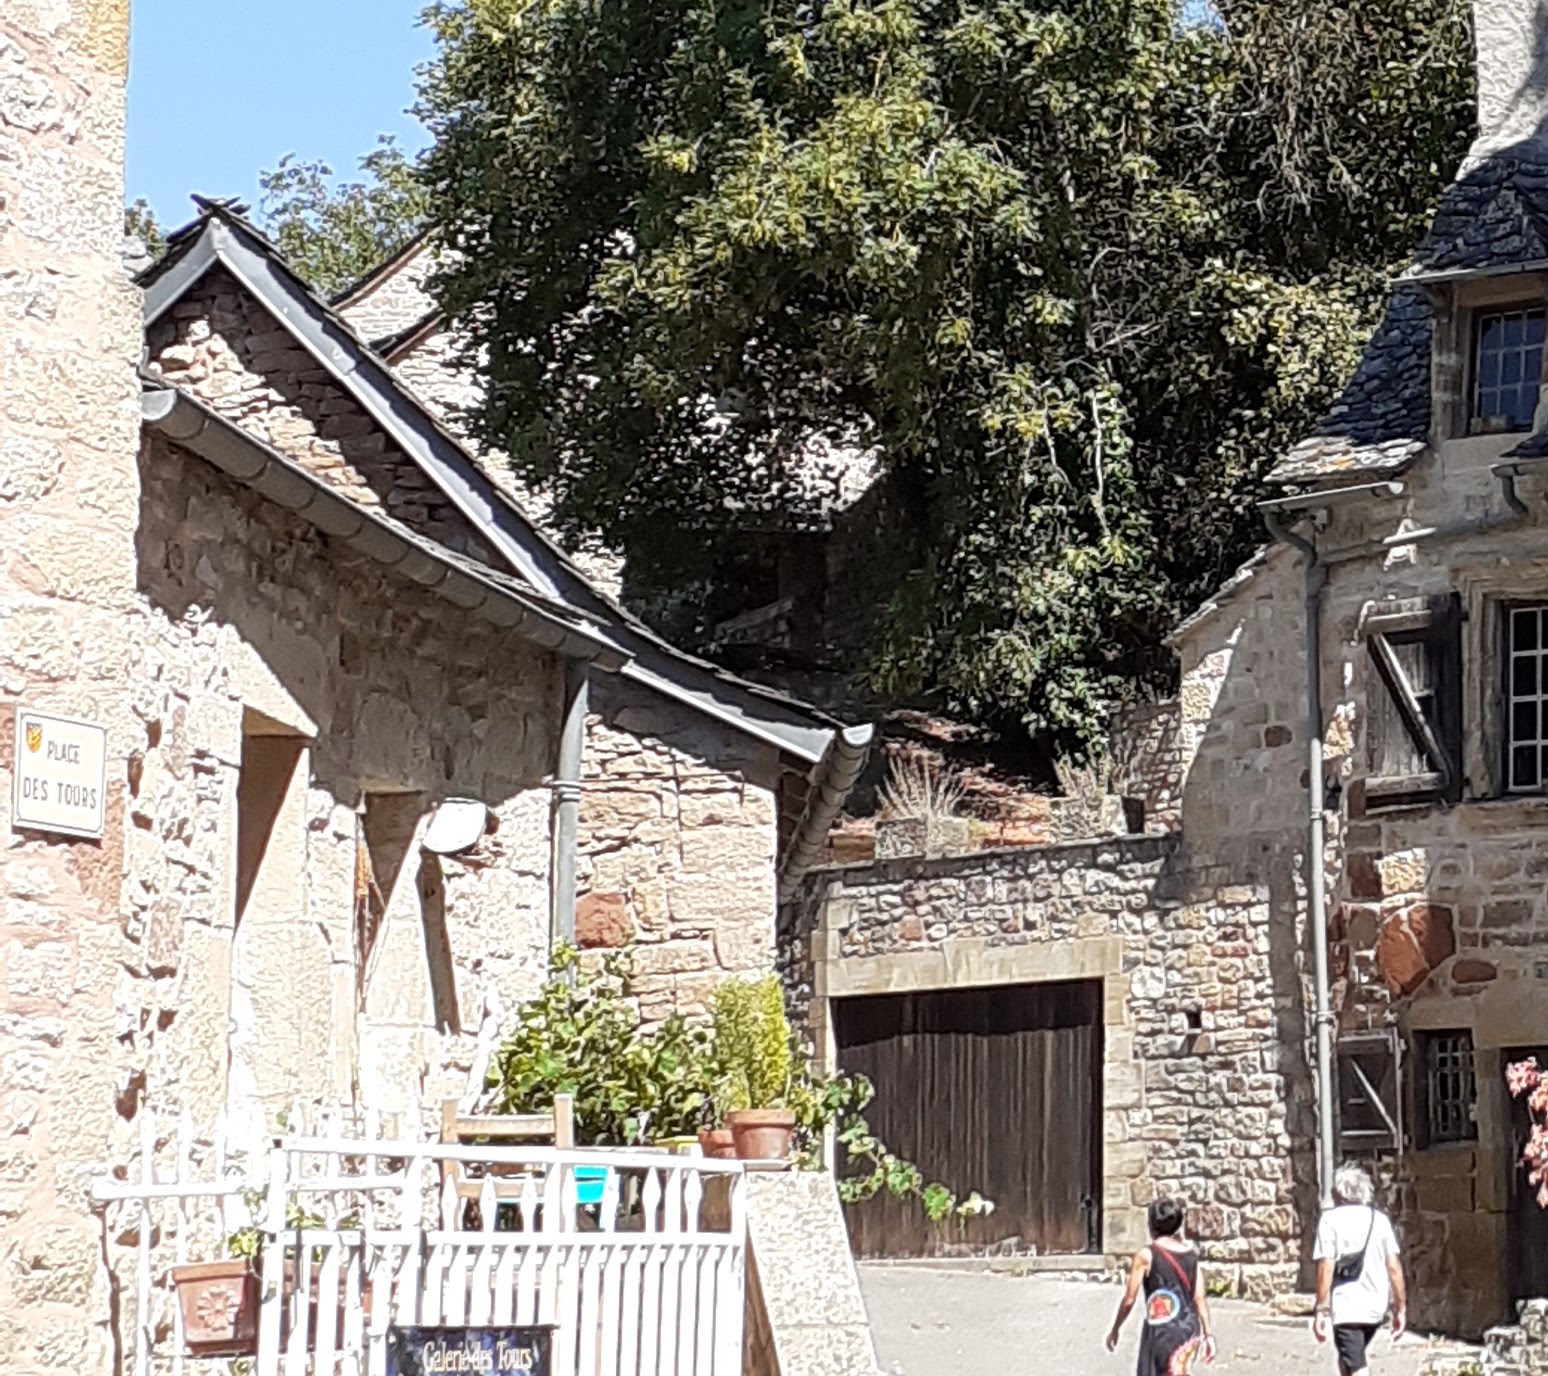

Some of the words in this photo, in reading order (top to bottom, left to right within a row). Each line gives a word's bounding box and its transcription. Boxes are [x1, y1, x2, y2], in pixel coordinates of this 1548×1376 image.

[47, 740, 80, 764] PLACE
[23, 776, 48, 801] DES
[57, 782, 97, 809] TOURS
[423, 1341, 469, 1373] Galerie
[471, 1341, 493, 1371] des
[496, 1340, 533, 1371] Tours
